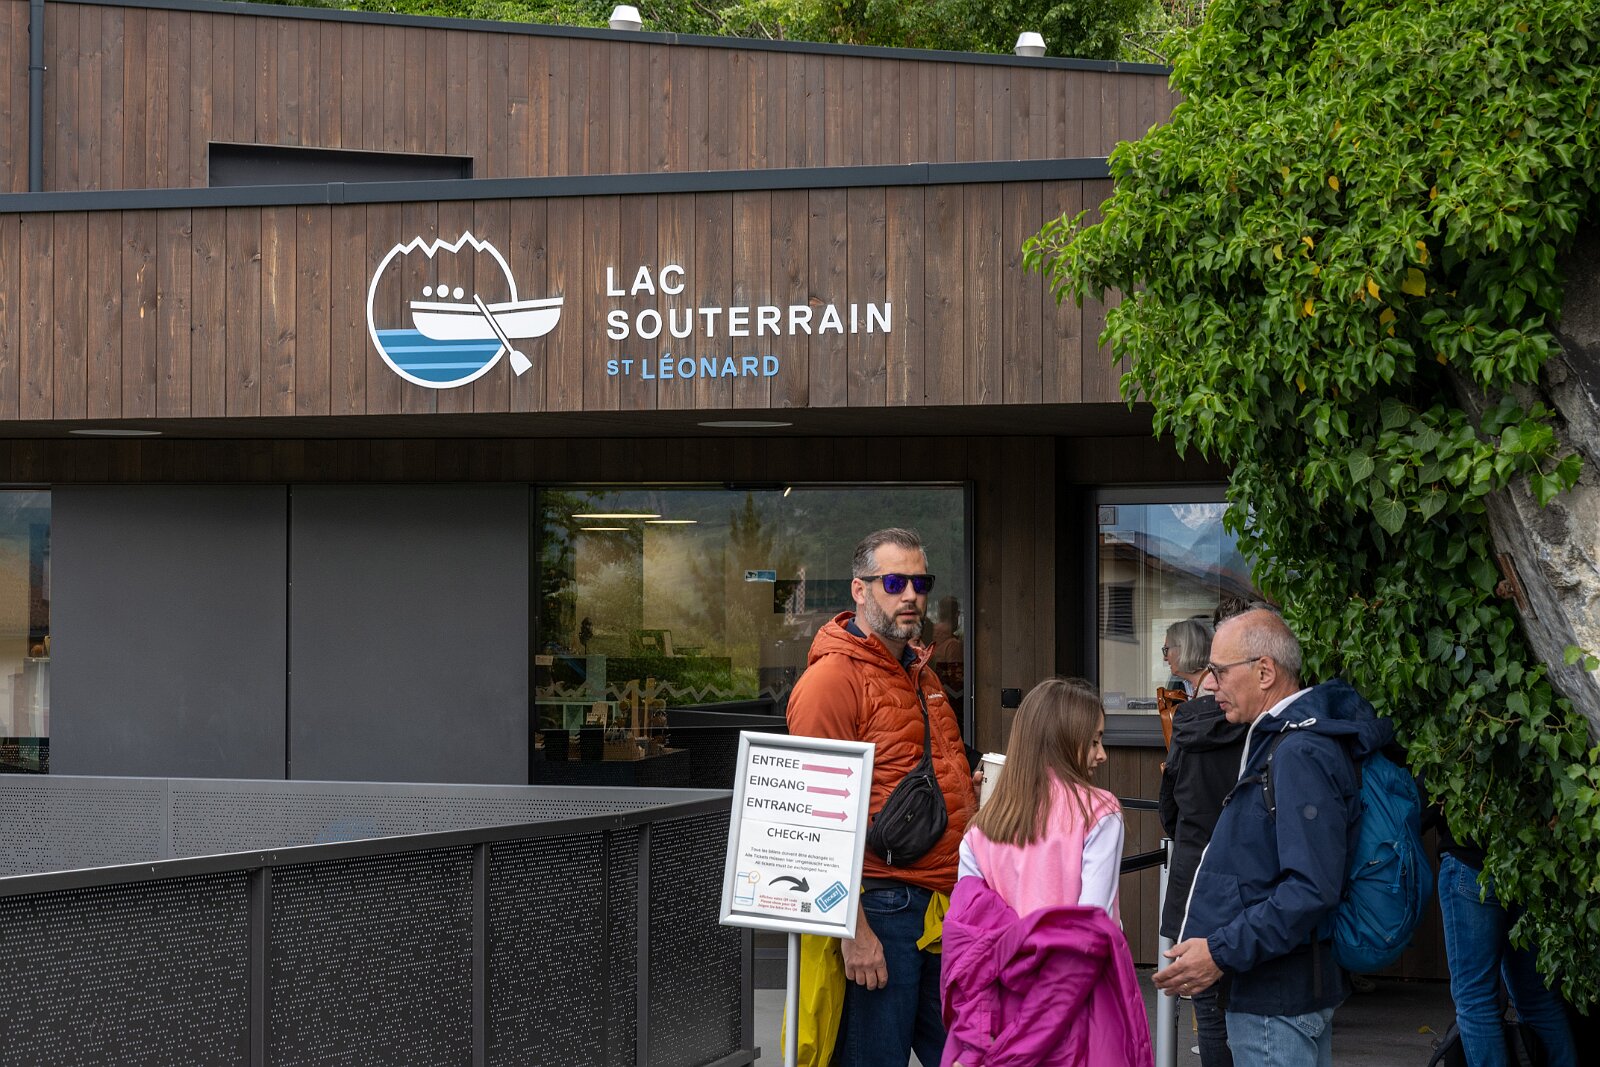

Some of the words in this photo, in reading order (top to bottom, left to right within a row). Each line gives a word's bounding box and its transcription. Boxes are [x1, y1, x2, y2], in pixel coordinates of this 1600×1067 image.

[606, 264, 685, 297] LAC
[606, 302, 892, 340] SOUTERRAIN
[607, 359, 634, 376] ST
[642, 353, 780, 379] LÉONARD
[752, 754, 800, 770] ENTREE
[749, 775, 805, 791] EINGANG
[746, 797, 813, 815] ENTRANCE
[767, 827, 821, 843] CHECK-IN
